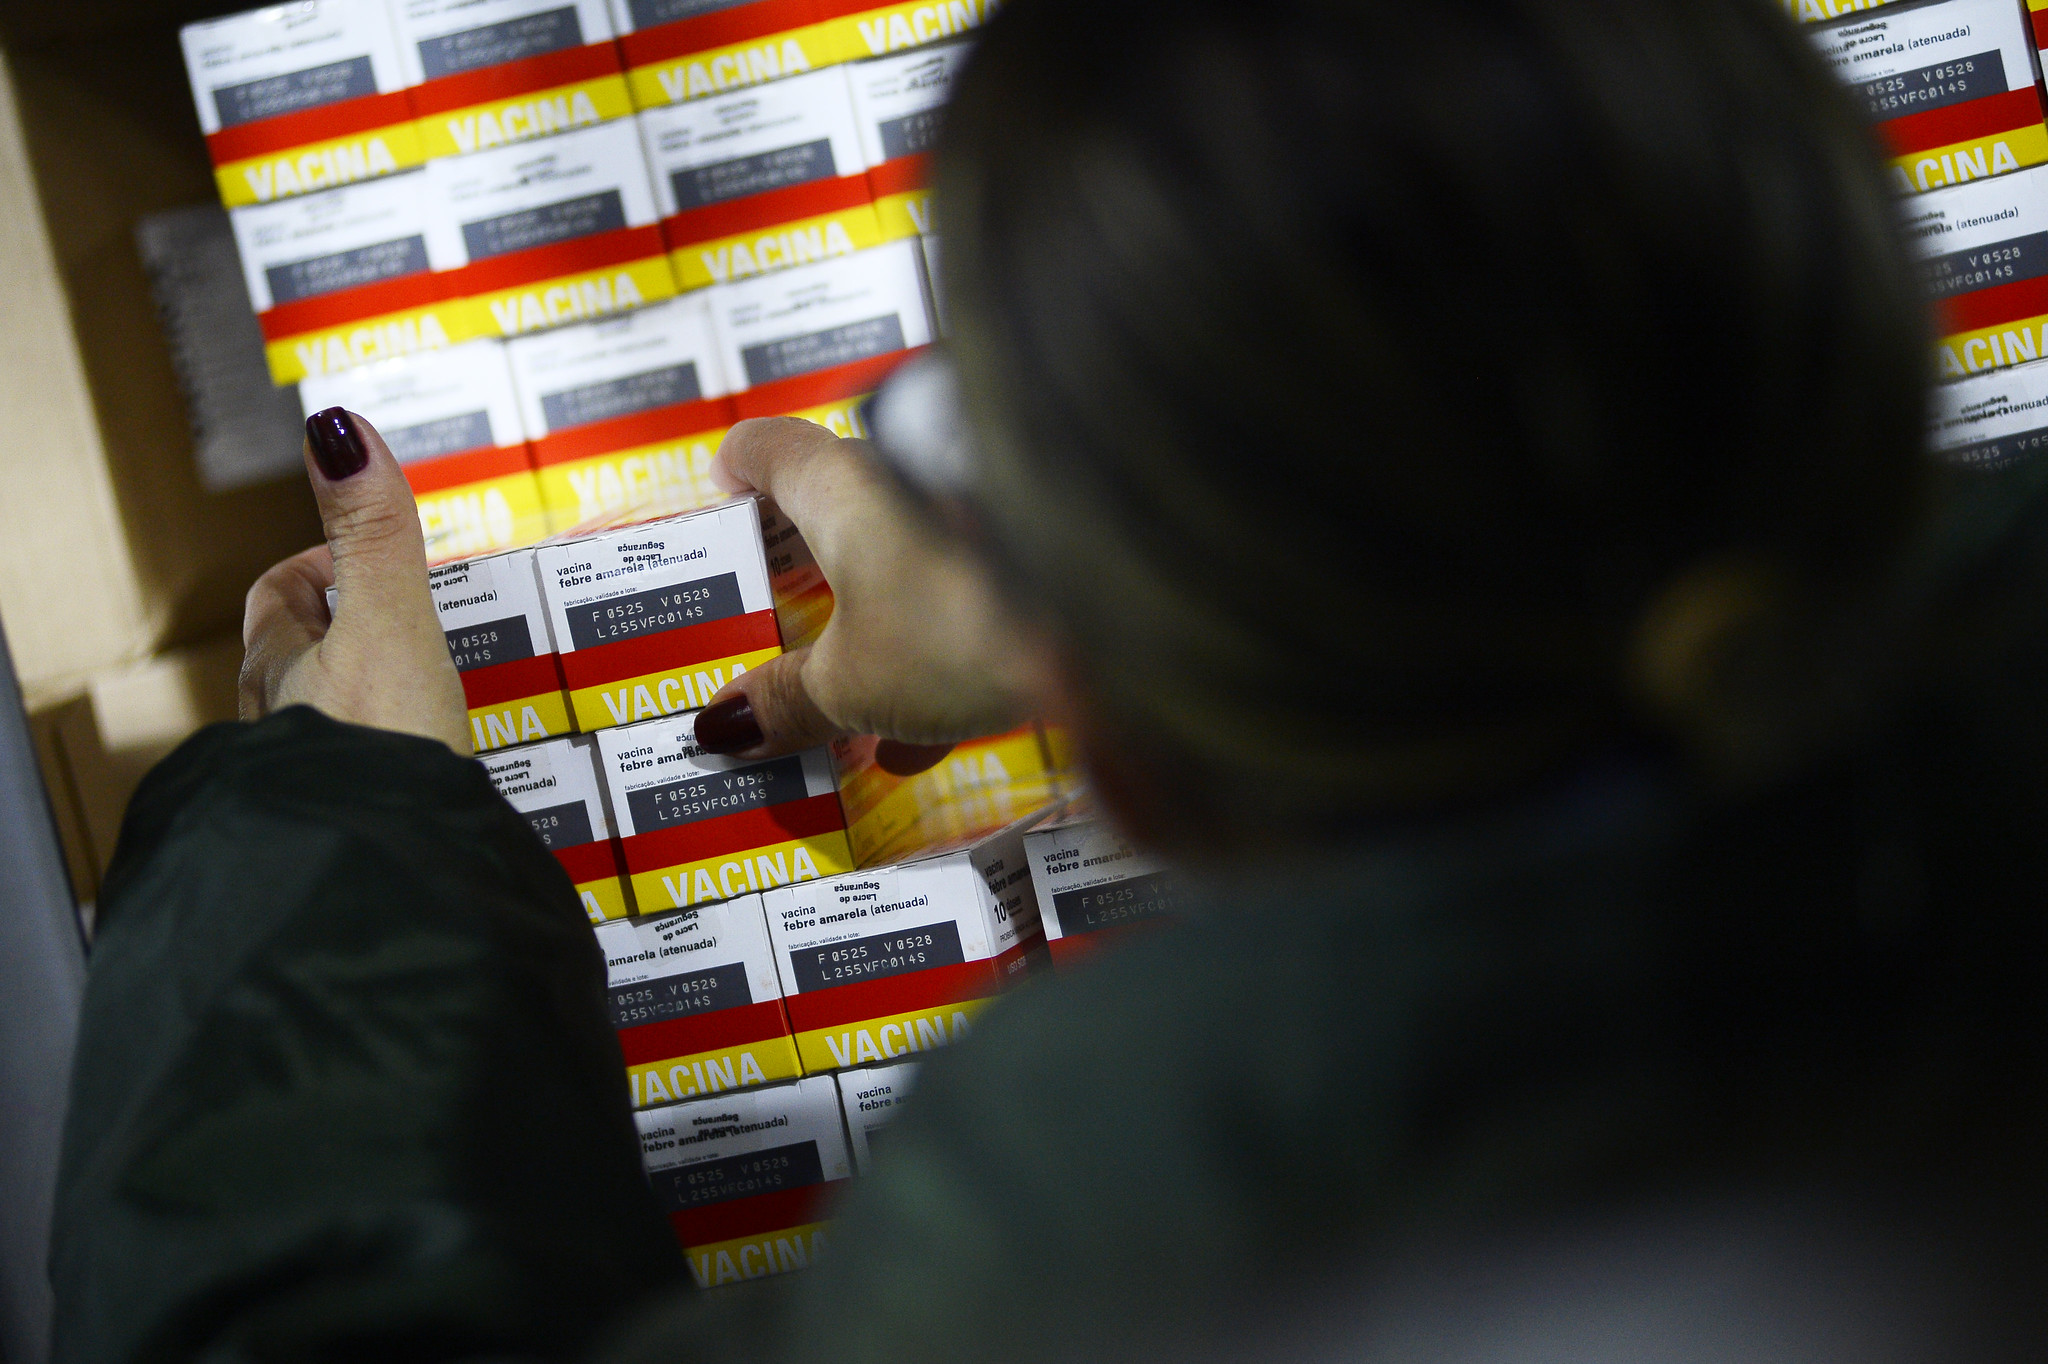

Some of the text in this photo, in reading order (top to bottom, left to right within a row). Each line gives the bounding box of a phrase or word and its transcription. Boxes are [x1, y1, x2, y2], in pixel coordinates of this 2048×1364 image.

[1853, 43, 1904, 63] amarela
[1908, 25, 1971, 50] (atenuada)
[657, 39, 811, 101] VACINA
[1922, 72, 1931, 83] V
[1936, 61, 1975, 79] 0528
[447, 91, 599, 154] VACINA
[244, 137, 397, 201] VACINA
[1892, 141, 2020, 193] ACINA
[1956, 206, 2019, 231] (atenuada)
[701, 222, 856, 284] VACINA
[1983, 247, 2021, 265] 0528
[490, 272, 644, 335] VACINA
[294, 313, 449, 378] VACINA
[1937, 323, 2048, 378] ACIN
[569, 442, 717, 506] VACINA
[617, 541, 665, 552] Segurança
[556, 562, 592, 576] vacina
[559, 547, 708, 589] febre amarela (atenuada)
[438, 589, 498, 612] (atenuada)
[592, 587, 711, 622] F 0525 V 0528
[597, 606, 704, 639] L 255VFC014S
[448, 631, 498, 651] V 0528
[617, 745, 654, 761] vacina
[504, 771, 530, 783] Lacre
[620, 758, 653, 773] febre
[497, 775, 557, 797] atenuada)
[654, 770, 774, 805] F 0525 V 0528
[658, 788, 767, 821] L 255VFC014S
[531, 816, 559, 831] 528
[1043, 848, 1079, 863] vacina
[1046, 849, 1133, 875] febre amarela
[661, 846, 822, 909] VACINA
[834, 882, 880, 893] Segurança
[839, 893, 877, 904] Lacre de
[1082, 897, 1089, 909] F
[1096, 888, 1134, 905] 0525
[654, 910, 699, 933] Segurança
[781, 905, 817, 920] vacina
[783, 894, 929, 932] febre amarela (atenuada)
[993, 901, 1007, 924] 10
[1086, 914, 1095, 924] L
[662, 922, 699, 941] Lacre de
[608, 936, 717, 967] amarela (atenuada)
[818, 934, 933, 965] F 0525 V 0528
[821, 952, 926, 981] L 255VFC014S
[617, 977, 718, 1006] 0525 V 0528
[825, 1011, 973, 1068] VACINA
[856, 1084, 892, 1100] vacina
[858, 1096, 892, 1112] febre
[692, 1113, 740, 1126] Segurança
[640, 1127, 675, 1142] vacina
[643, 1138, 675, 1153] febre
[731, 1115, 789, 1137] (atenuada)
[688, 1169, 724, 1186] 0525
